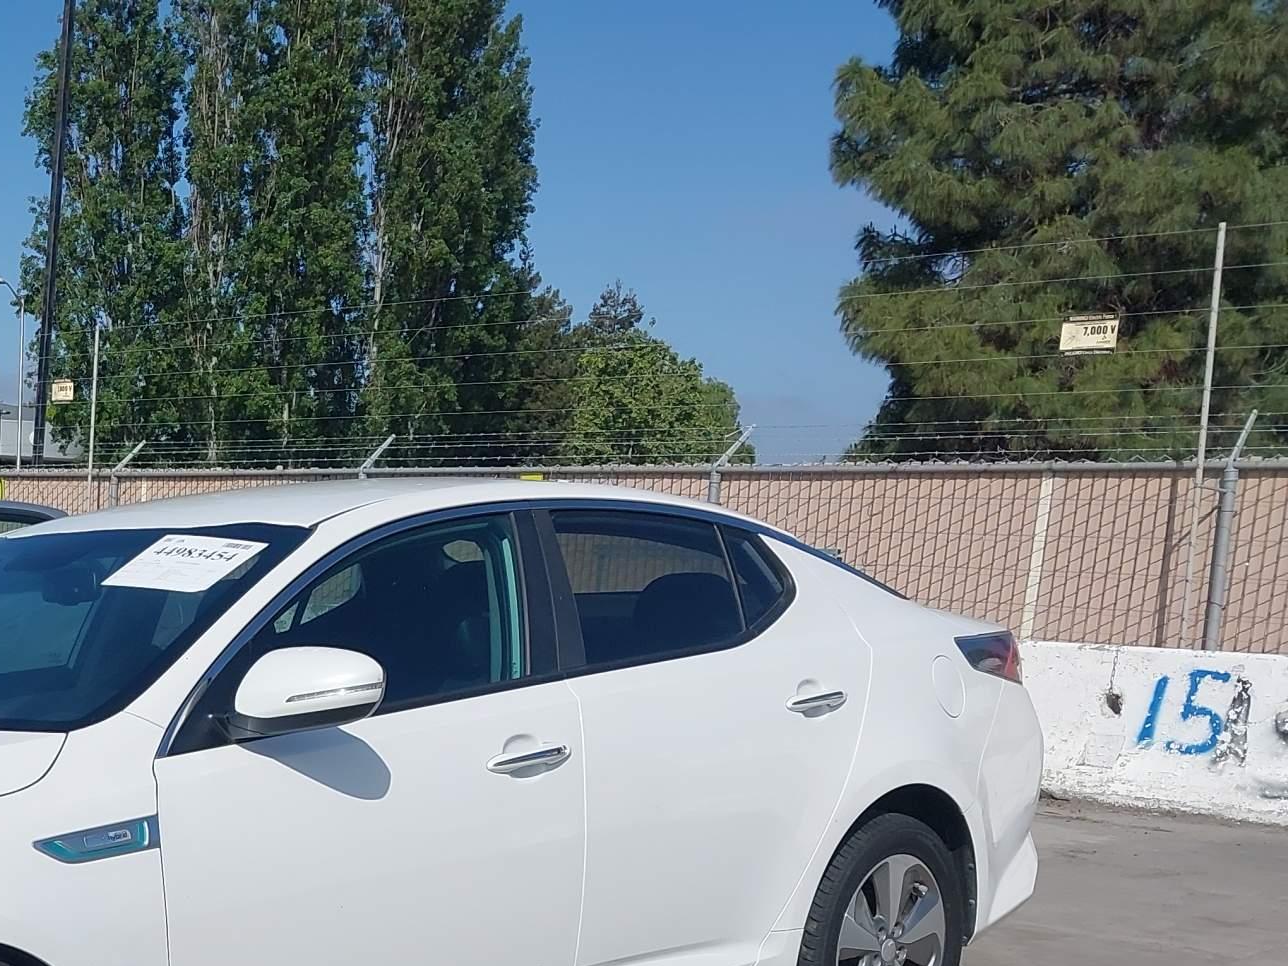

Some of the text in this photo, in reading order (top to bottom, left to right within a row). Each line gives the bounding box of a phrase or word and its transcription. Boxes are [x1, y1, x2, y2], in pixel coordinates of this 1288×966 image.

[1083, 324, 1117, 337] 7,000 V
[153, 545, 239, 563] 44983454
